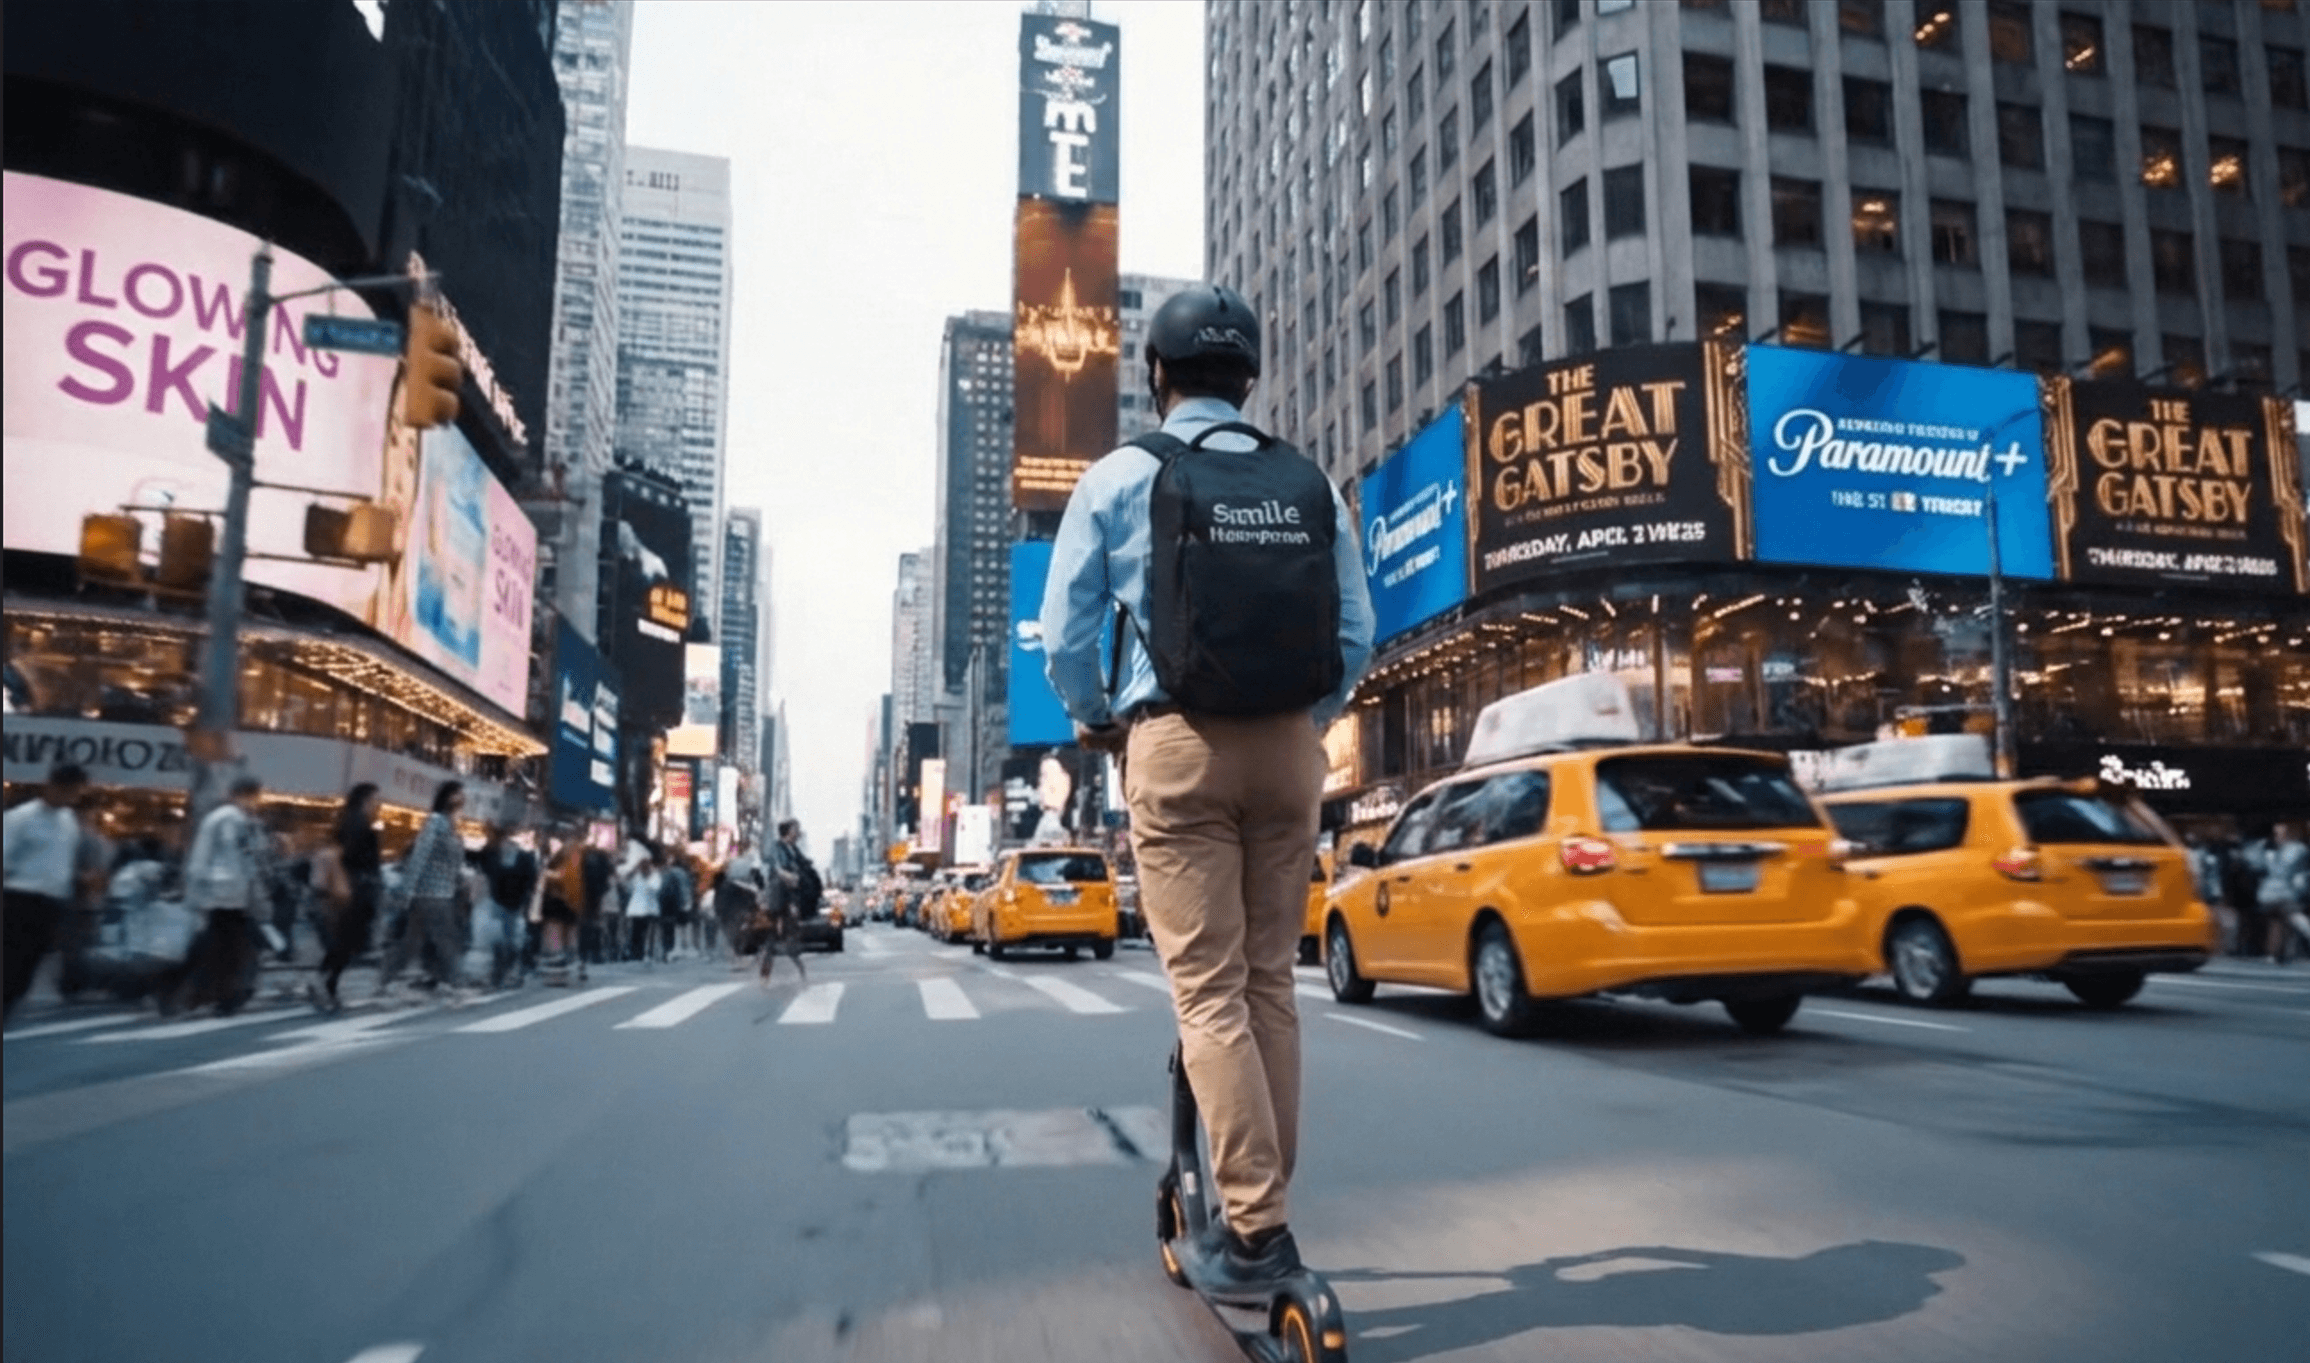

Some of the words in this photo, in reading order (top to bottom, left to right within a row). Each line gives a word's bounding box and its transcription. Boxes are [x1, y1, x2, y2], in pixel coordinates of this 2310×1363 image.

[6, 240, 339, 379] GLOWNG
[57, 319, 307, 452] SKIN
[1547, 363, 1595, 396] THE
[1489, 380, 1687, 464] GREAT
[2086, 418, 2254, 478] GREAT
[1494, 438, 1679, 512] GATSBY
[2096, 471, 2252, 523] GATSBY
